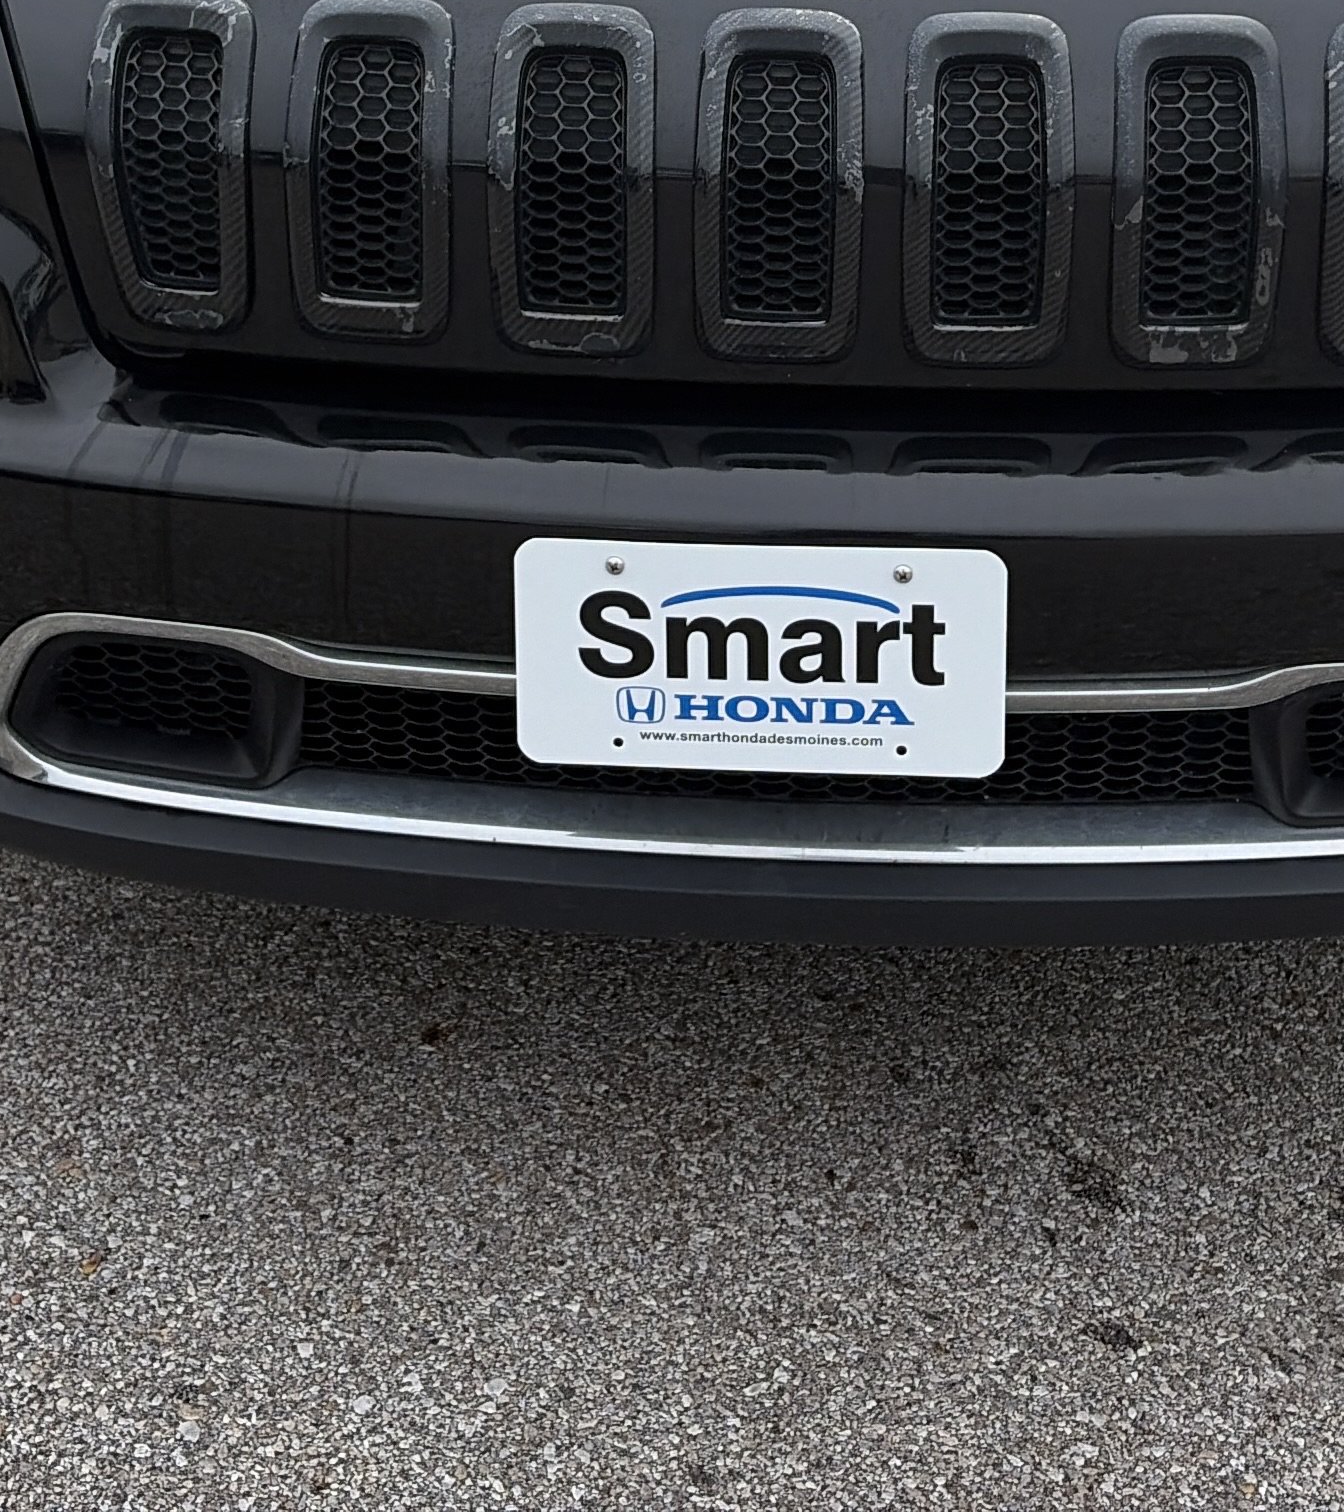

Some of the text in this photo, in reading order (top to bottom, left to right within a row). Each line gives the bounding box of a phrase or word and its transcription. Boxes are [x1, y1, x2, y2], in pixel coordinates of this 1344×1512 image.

[578, 590, 946, 686] Smart
[674, 693, 915, 726] HONDA
[639, 729, 884, 748] www.smarthondadesmoines.com
